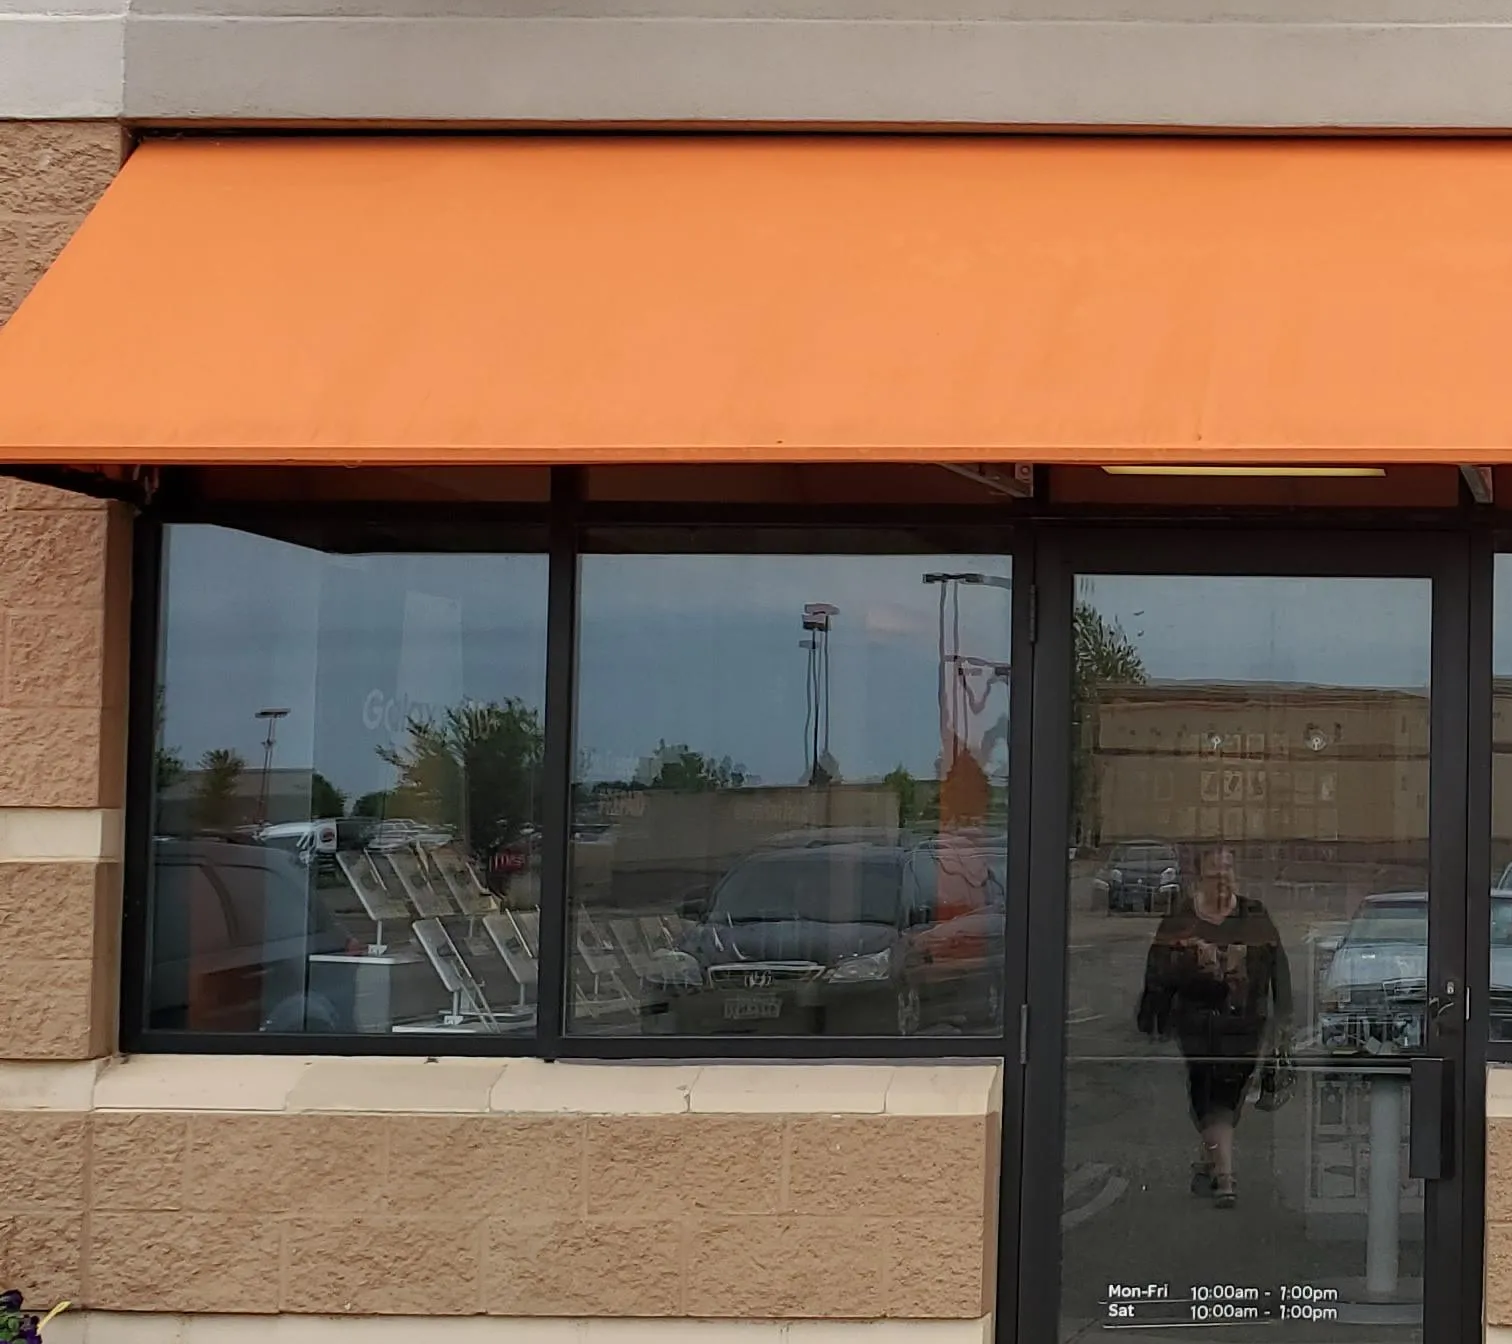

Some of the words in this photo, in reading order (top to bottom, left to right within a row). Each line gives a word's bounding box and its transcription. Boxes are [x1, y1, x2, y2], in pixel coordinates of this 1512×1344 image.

[1108, 1283, 1169, 1298] Mon-Fri
[1191, 1285, 1259, 1301] 10:00am
[1108, 1303, 1135, 1317] Sat
[1190, 1304, 1258, 1320] 10:00am
